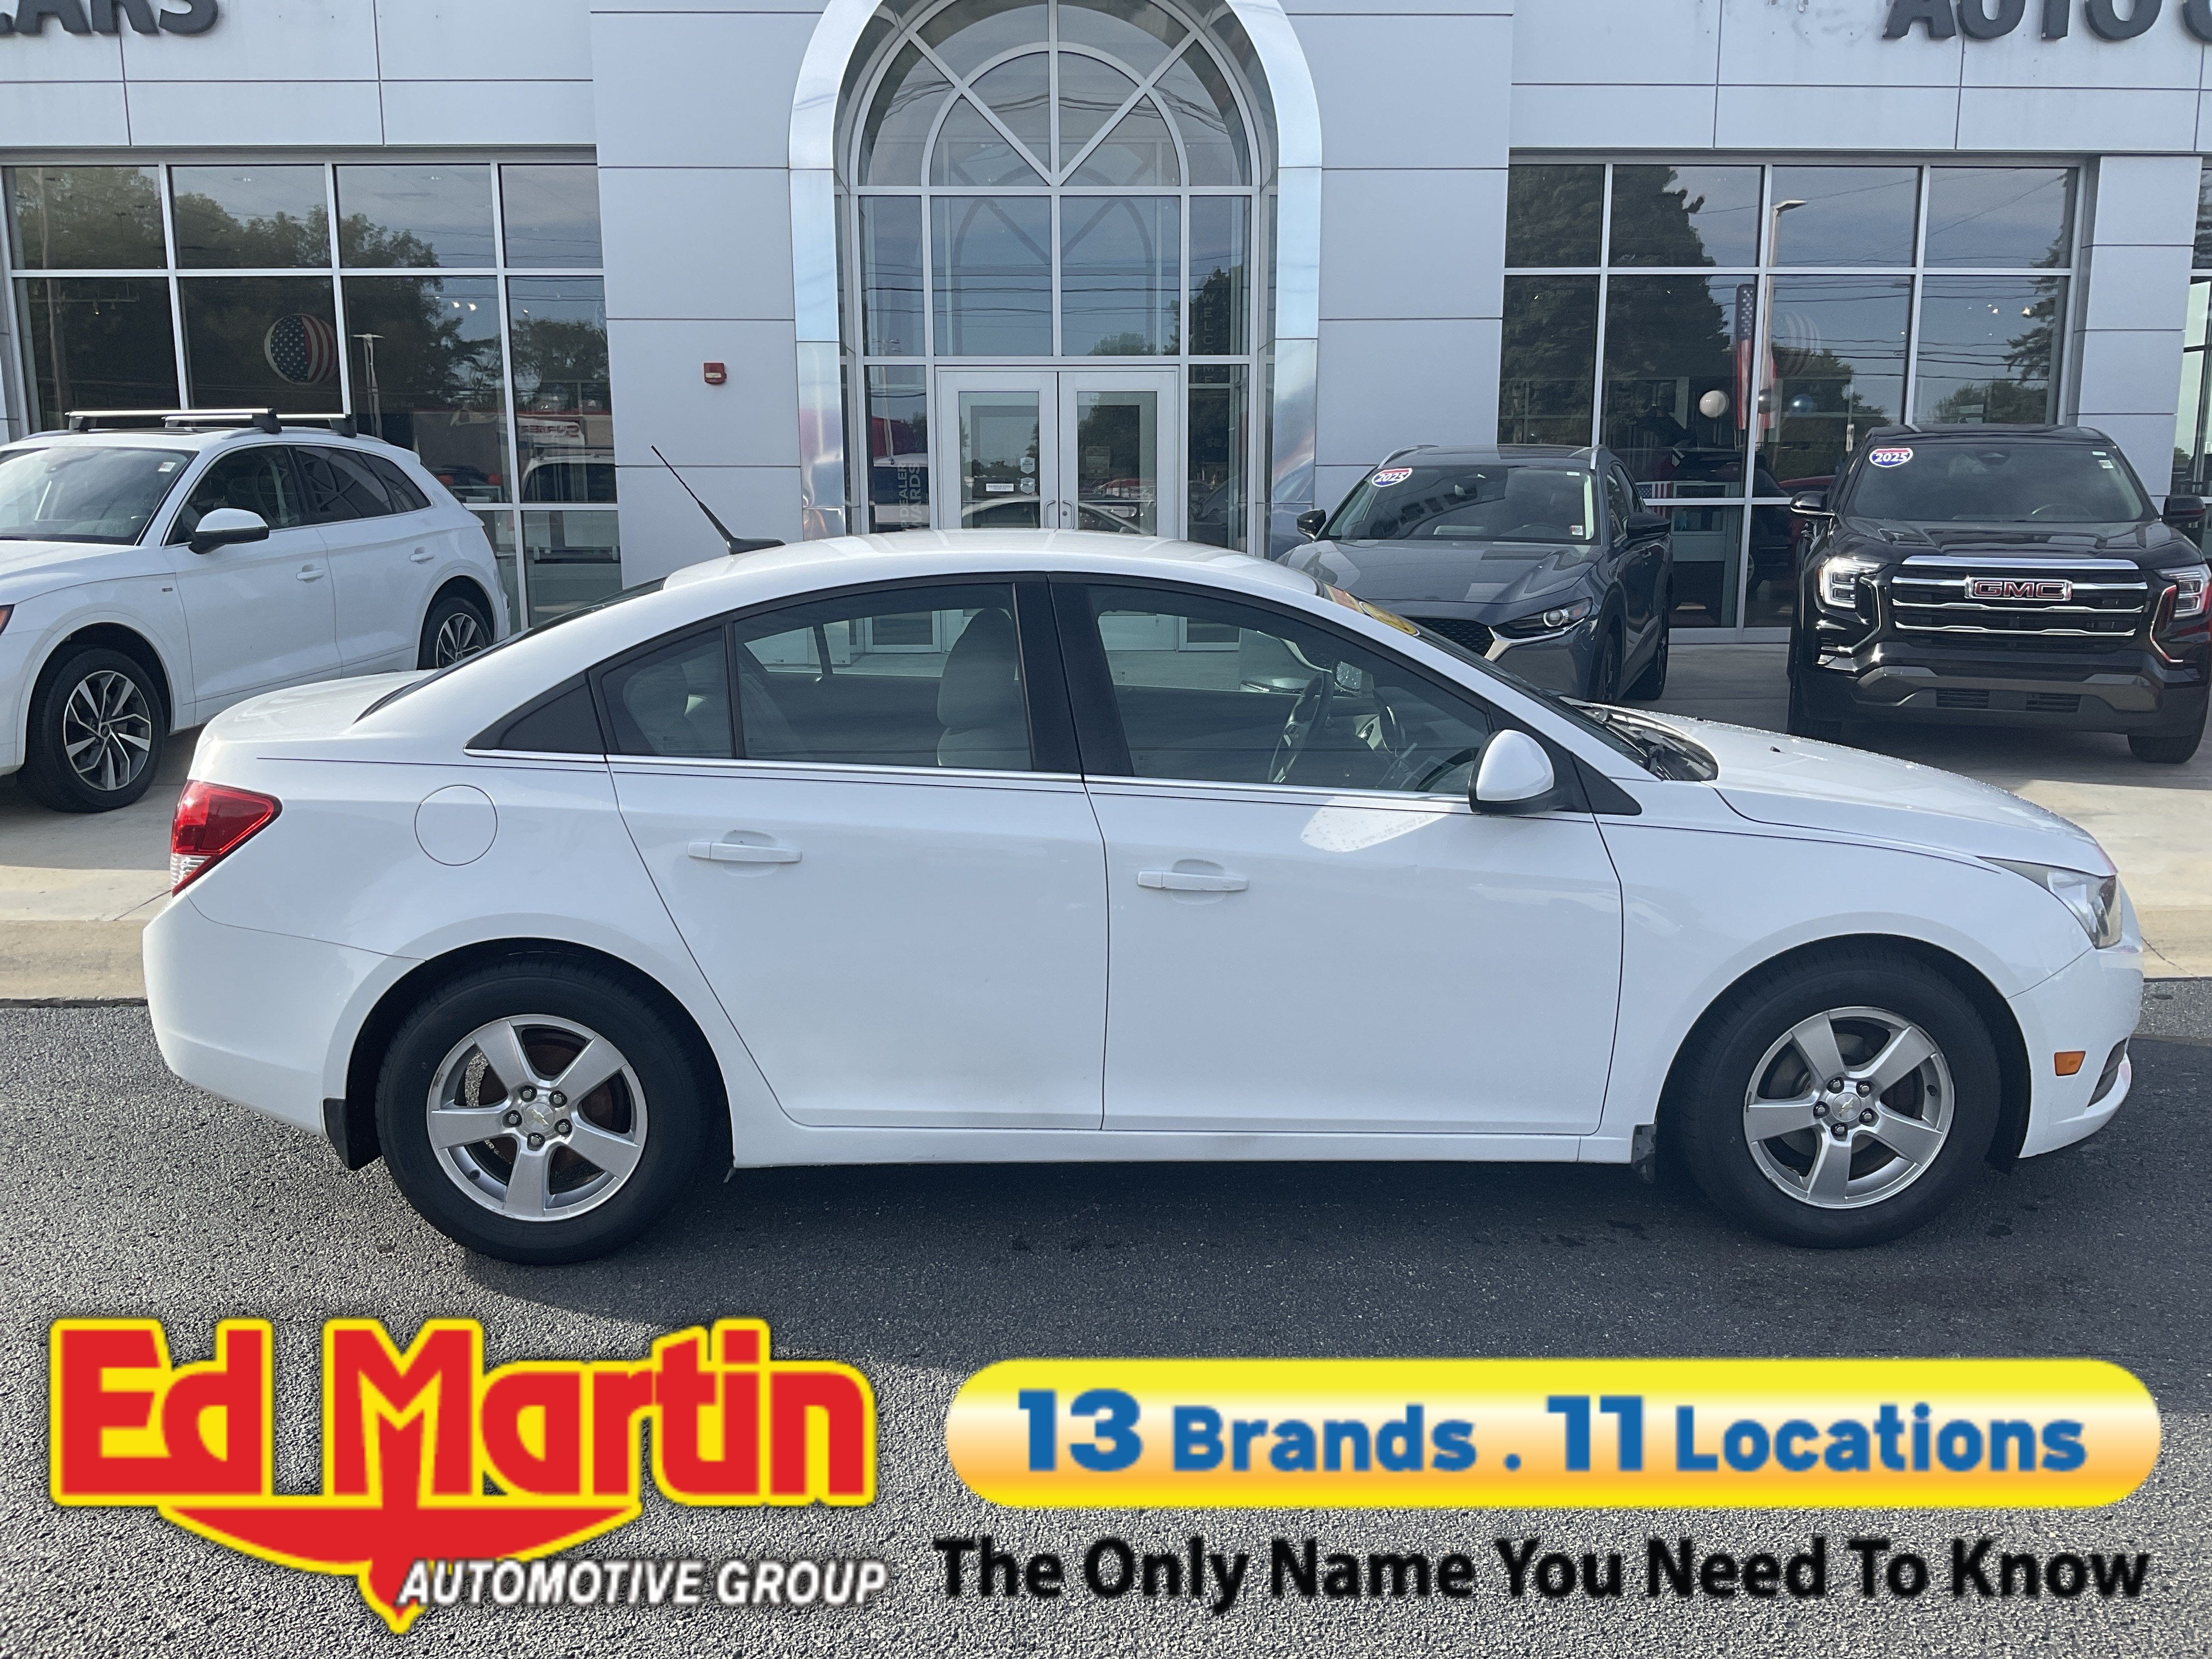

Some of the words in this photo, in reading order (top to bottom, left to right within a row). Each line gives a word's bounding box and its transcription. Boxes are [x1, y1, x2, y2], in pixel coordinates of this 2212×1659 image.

[0, 0, 218, 34] ARS
[1875, 452, 1908, 462] 2025
[1374, 472, 1407, 482] 2025
[897, 462, 910, 517] DEALER
[1974, 580, 2064, 599] GMC
